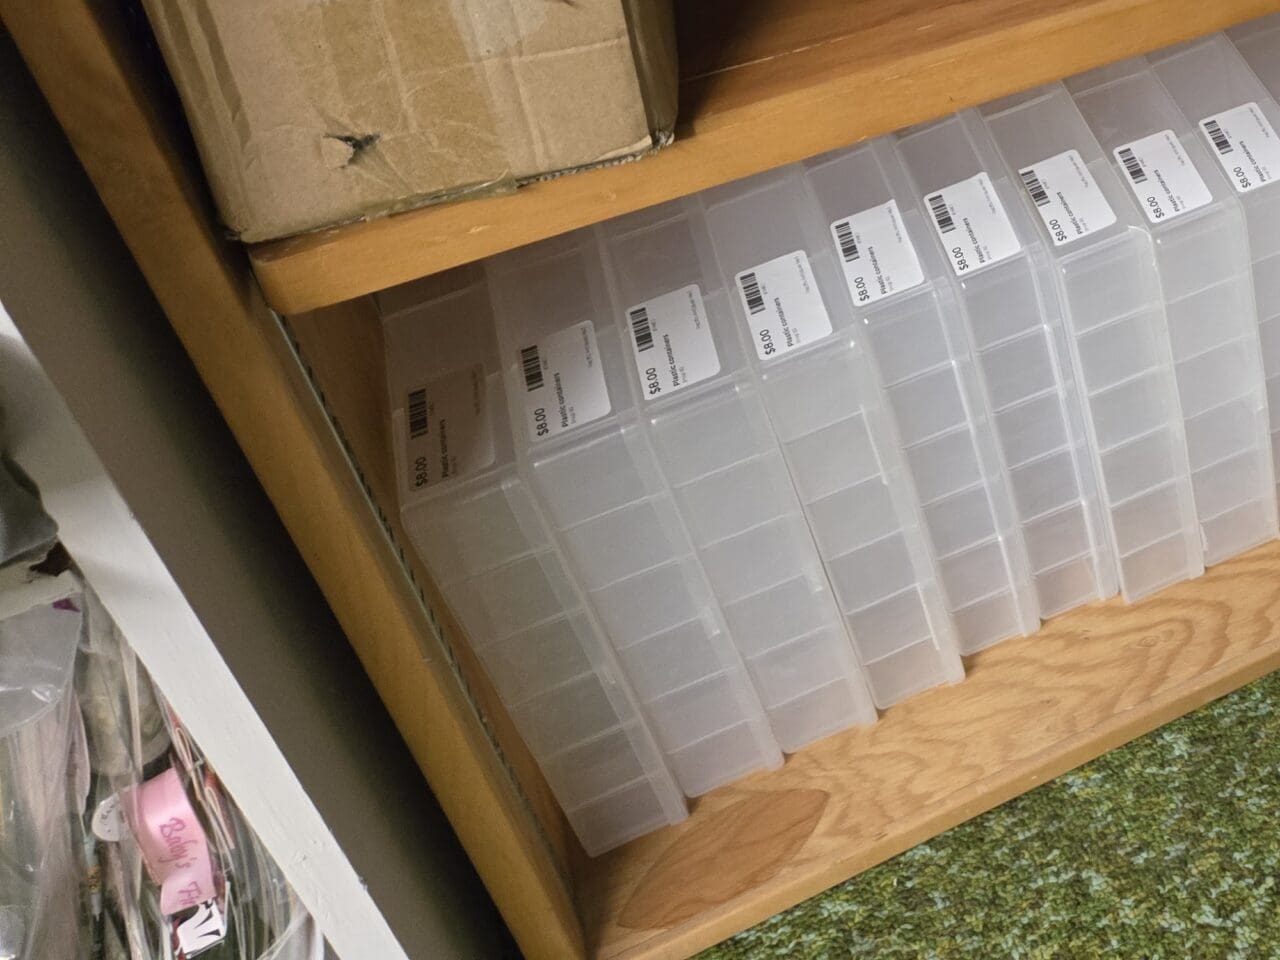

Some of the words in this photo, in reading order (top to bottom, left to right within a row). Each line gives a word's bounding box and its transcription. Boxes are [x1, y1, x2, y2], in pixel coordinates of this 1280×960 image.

[1236, 140, 1257, 166] containers
[1151, 168, 1171, 195] containers
[1231, 165, 1252, 189] $8.00
[1251, 164, 1267, 183] Plastic
[1054, 190, 1074, 218] containers
[1145, 194, 1165, 219] $8.00
[1165, 193, 1181, 212] Plastic
[960, 216, 978, 245] containers
[1047, 217, 1068, 242] $8.00
[1068, 216, 1083, 235] Plastic
[865, 245, 881, 275] containers
[950, 245, 969, 271] $8.00
[972, 243, 986, 264] Plastic
[852, 275, 870, 302] $8.00
[874, 274, 887, 295] Plastic
[771, 296, 788, 327] containers
[660, 333, 675, 366] containers
[757, 327, 776, 356] $8.00
[781, 325, 794, 348] Plastic
[551, 371, 565, 406] containers
[644, 365, 661, 395] $8.00
[668, 364, 680, 387] Plastic
[532, 405, 549, 437] $8.00
[557, 404, 569, 428] Plastic
[413, 453, 428, 488] $8.00
